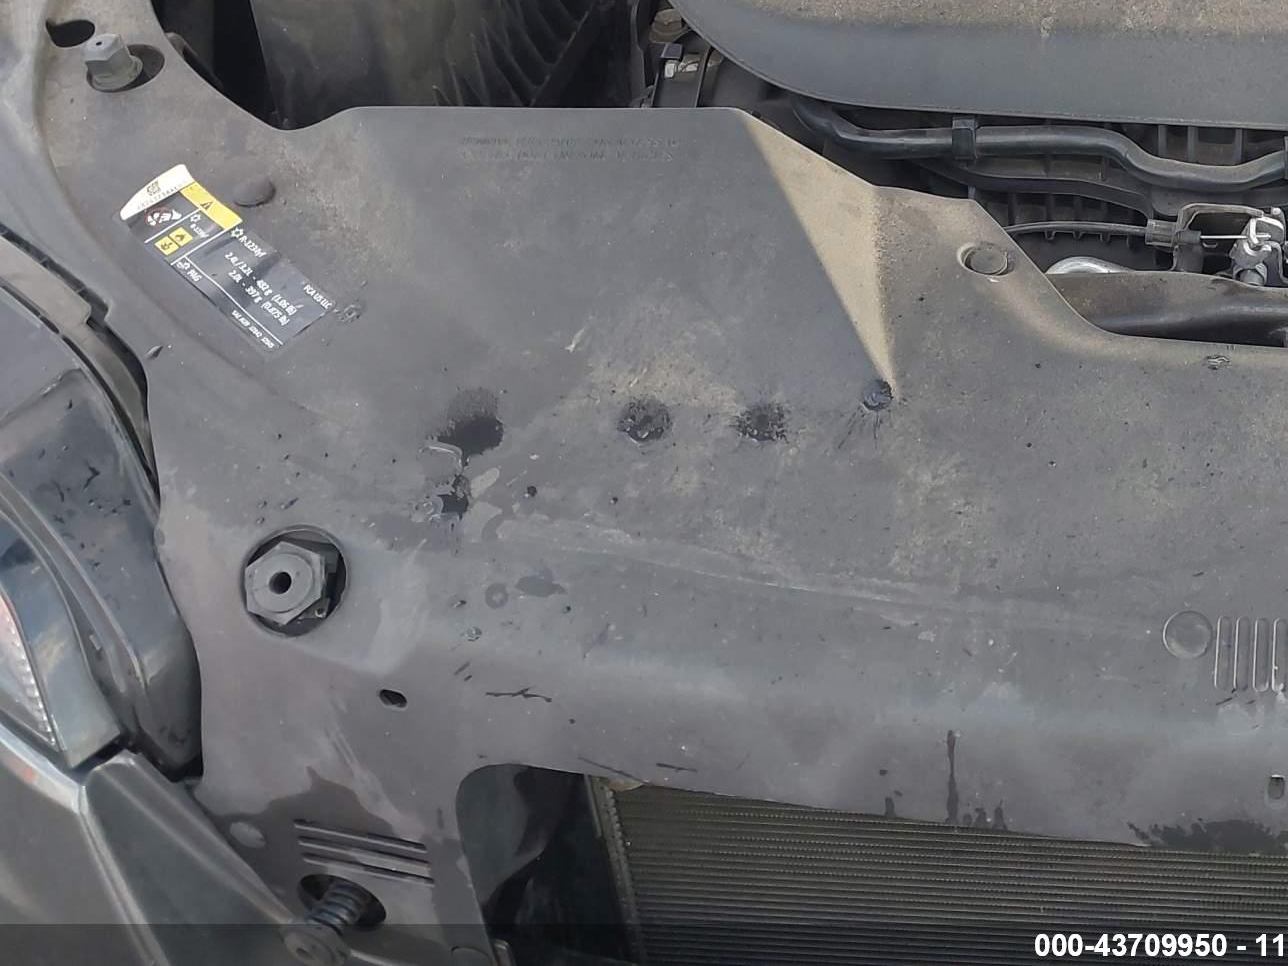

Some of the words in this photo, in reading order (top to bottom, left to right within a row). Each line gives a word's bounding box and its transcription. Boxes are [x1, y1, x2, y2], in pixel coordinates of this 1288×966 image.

[239, 234, 267, 258] R-1234yf
[187, 267, 203, 282] PAG
[245, 286, 258, 299] 397
[303, 284, 316, 297] FCA
[312, 292, 323, 303] US
[321, 299, 333, 310] LLC
